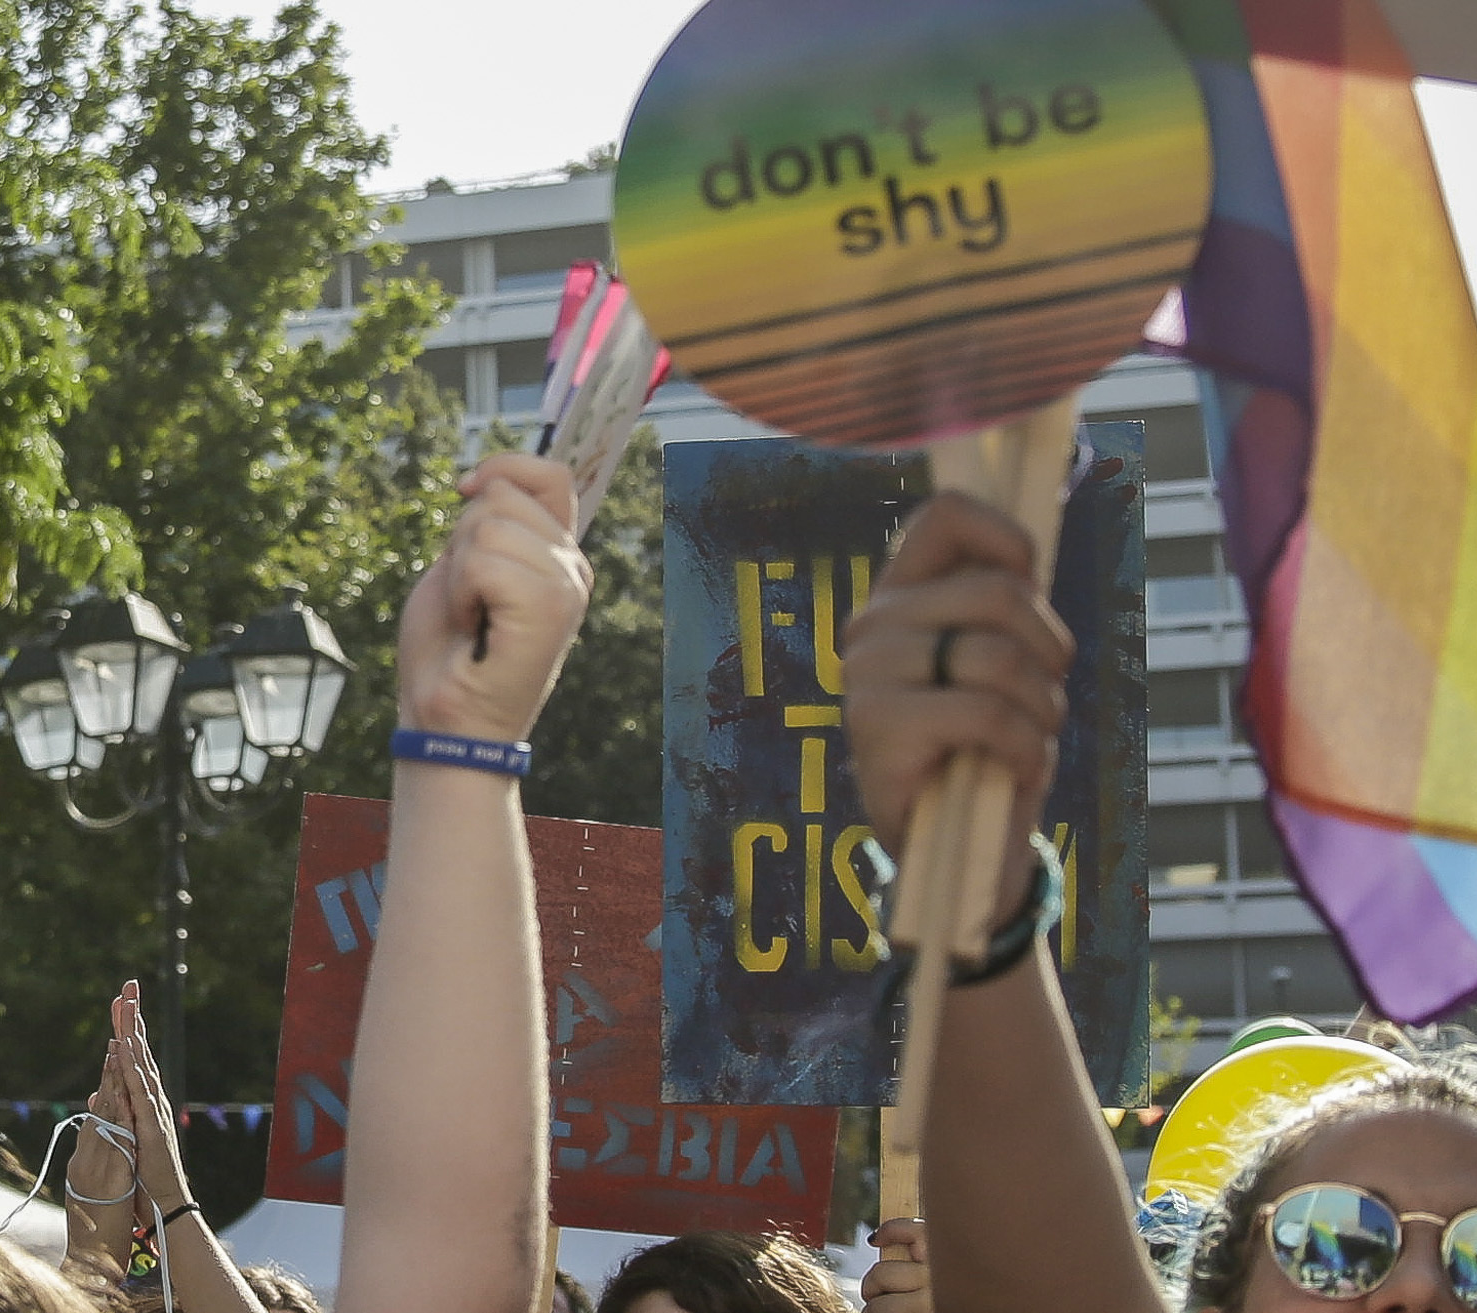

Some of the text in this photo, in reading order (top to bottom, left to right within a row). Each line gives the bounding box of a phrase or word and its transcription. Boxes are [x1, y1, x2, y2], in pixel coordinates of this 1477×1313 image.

[701, 82, 1102, 211] don't be
[838, 176, 1007, 256] shy
[551, 1096, 809, 1195] ΕΣΒΙΑ
